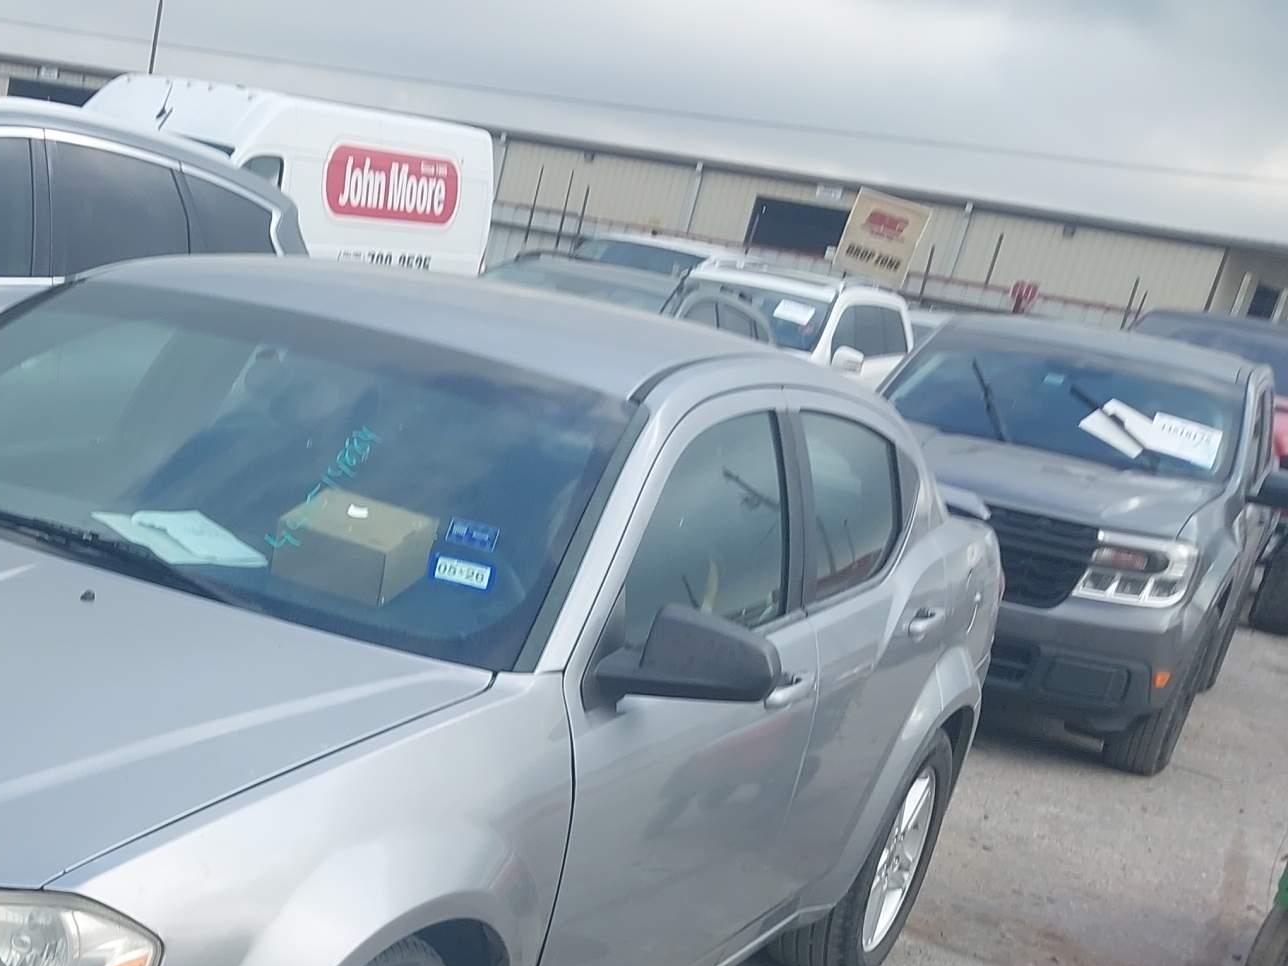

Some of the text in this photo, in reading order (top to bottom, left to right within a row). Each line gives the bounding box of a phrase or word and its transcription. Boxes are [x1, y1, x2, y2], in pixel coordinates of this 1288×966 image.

[338, 155, 446, 216] John Moore
[845, 243, 901, 271] DROP ZONE
